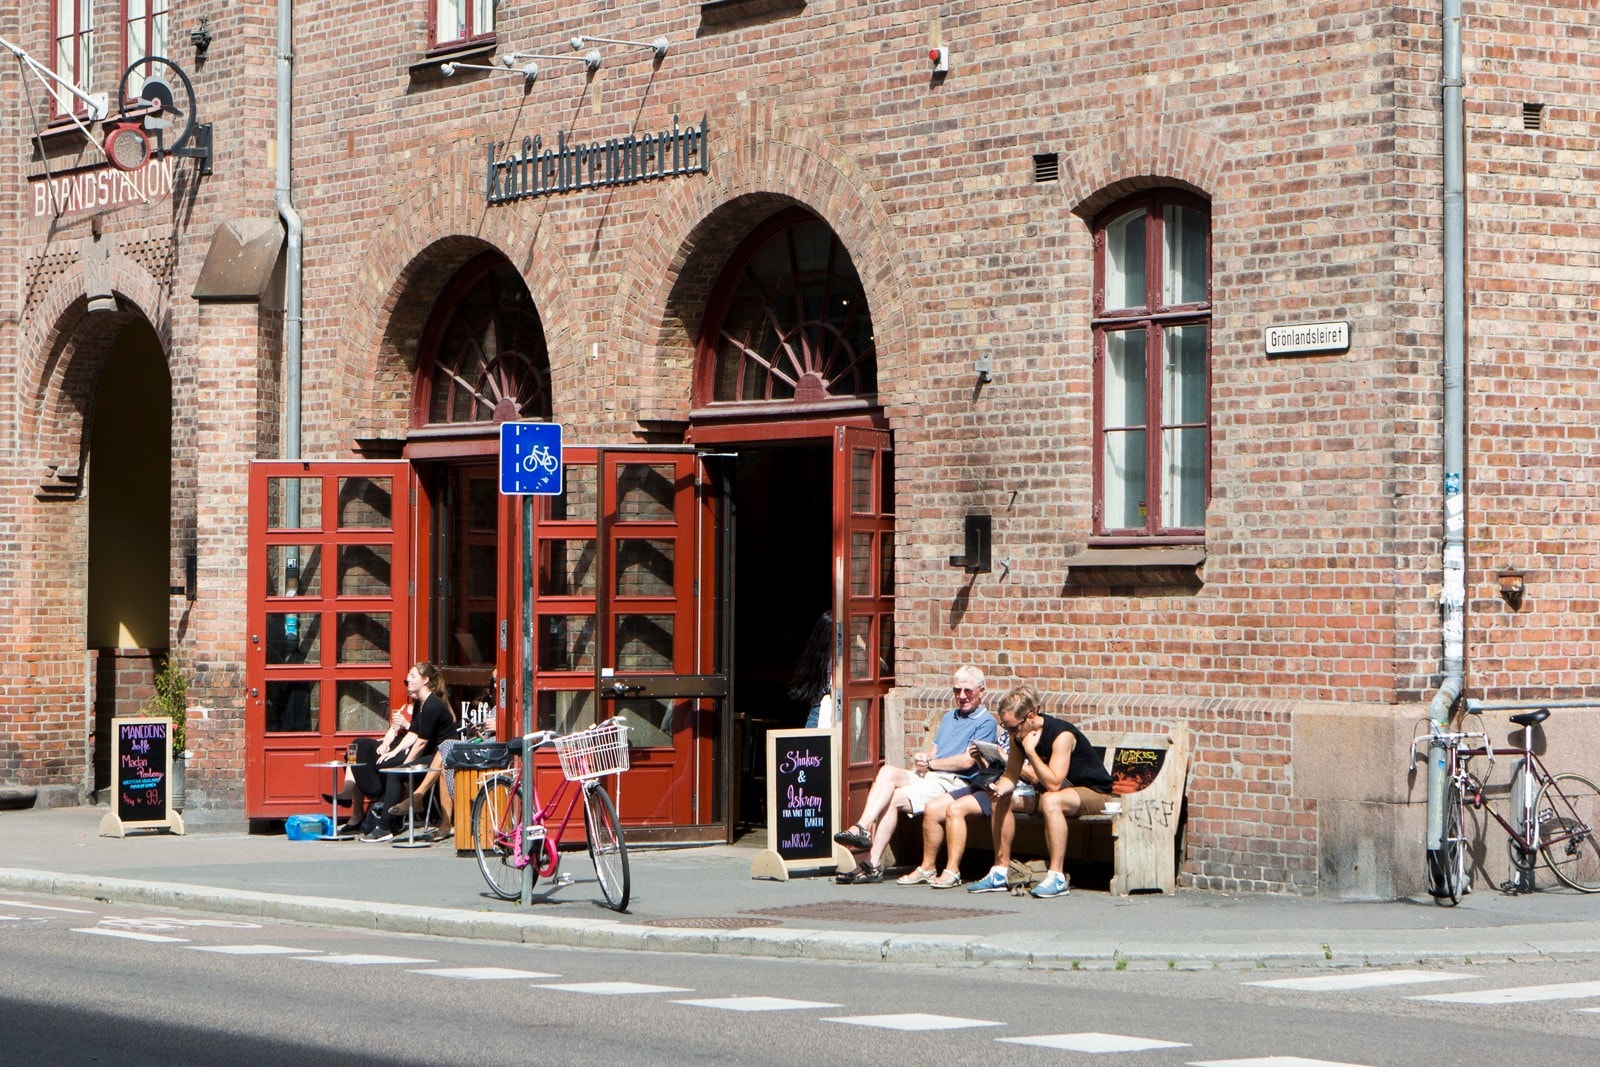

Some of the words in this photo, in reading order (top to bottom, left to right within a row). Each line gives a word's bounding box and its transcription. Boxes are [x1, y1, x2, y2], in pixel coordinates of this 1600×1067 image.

[34, 157, 174, 217] BRANDSTATION
[1271, 326, 1342, 347] Grönlandsleiret
[461, 701, 491, 727] Kaff
[780, 748, 823, 774] Shakes
[797, 770, 807, 783] &
[787, 785, 822, 812] Iskrem
